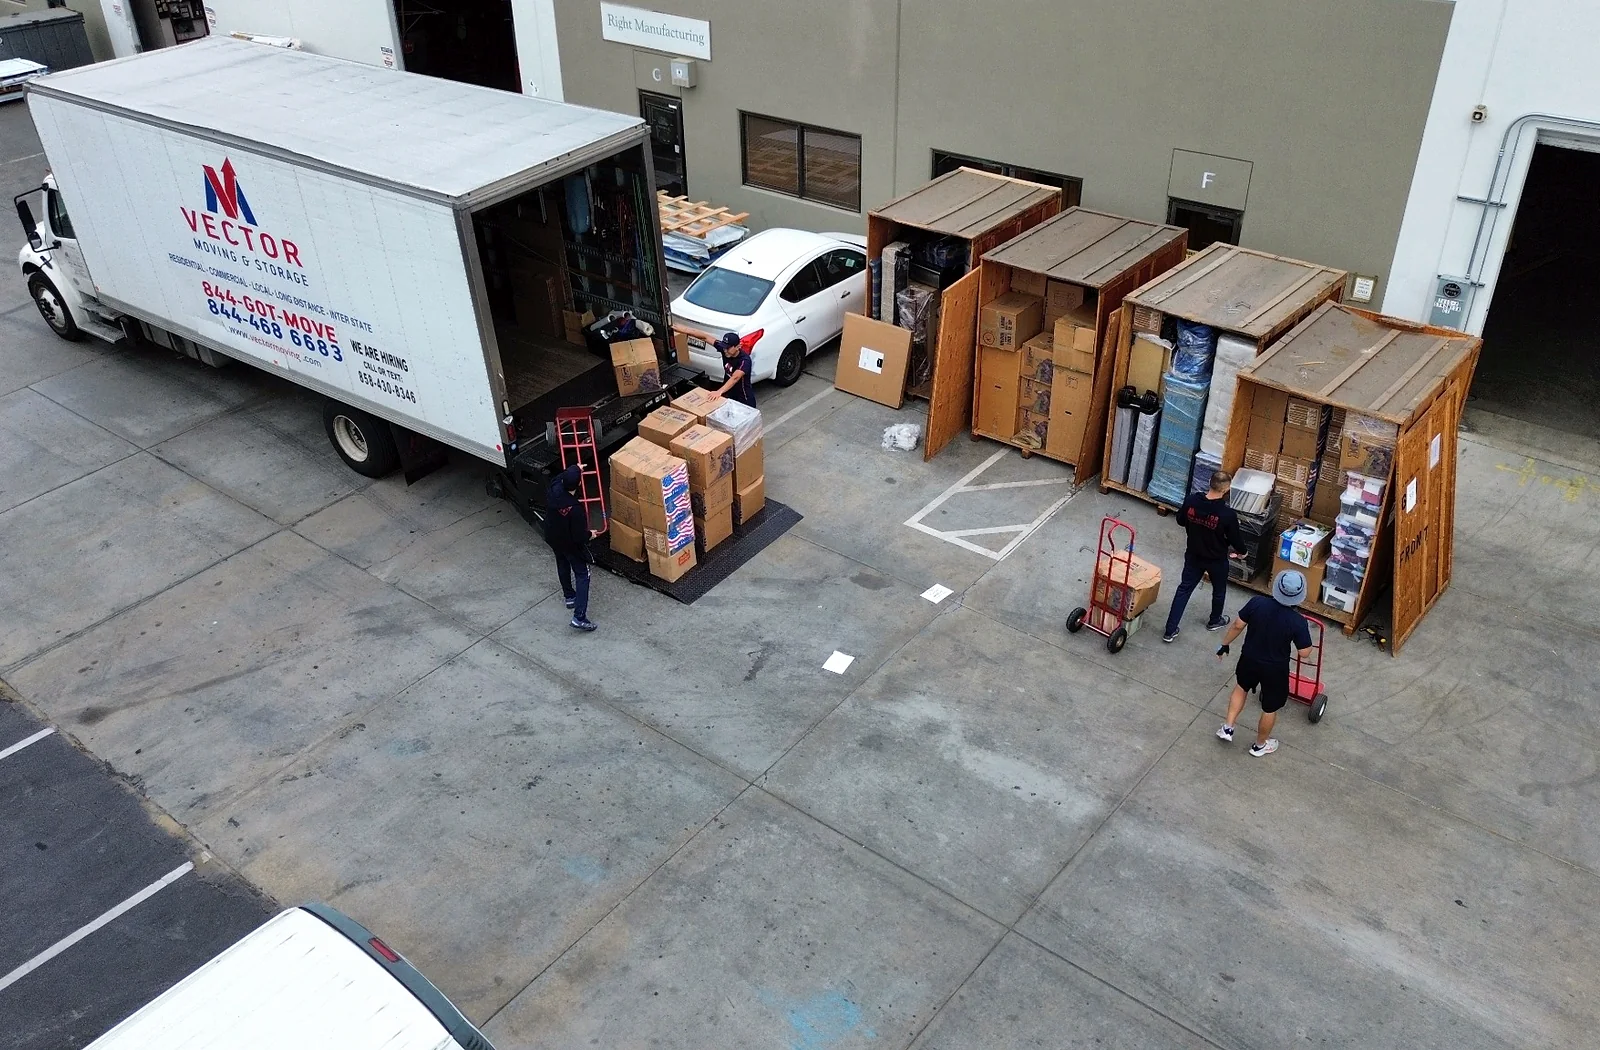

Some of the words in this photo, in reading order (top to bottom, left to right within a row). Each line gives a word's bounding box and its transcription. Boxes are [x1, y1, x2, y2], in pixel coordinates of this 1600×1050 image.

[607, 13, 633, 31] Right
[634, 18, 705, 46] Manufacturing
[1201, 171, 1216, 189] F
[180, 206, 304, 268] VECTOR
[193, 238, 237, 263] MOVING
[242, 255, 250, 267] &
[254, 259, 309, 287] STORAGE
[202, 280, 339, 344] 844-GOT-MOVE
[207, 298, 283, 340] 844-468
[289, 329, 343, 363] 6683
[251, 281, 273, 297] LOCAL
[274, 289, 293, 304] LONG
[293, 296, 326, 316] DISTANCE
[328, 310, 350, 325] INTER
[350, 317, 374, 334] STATE
[349, 339, 363, 355] WE
[364, 345, 380, 362] ARE
[380, 351, 409, 373] HIRING
[363, 361, 377, 373] CALL
[378, 367, 386, 377] OR
[1399, 525, 1429, 569] FRONT
